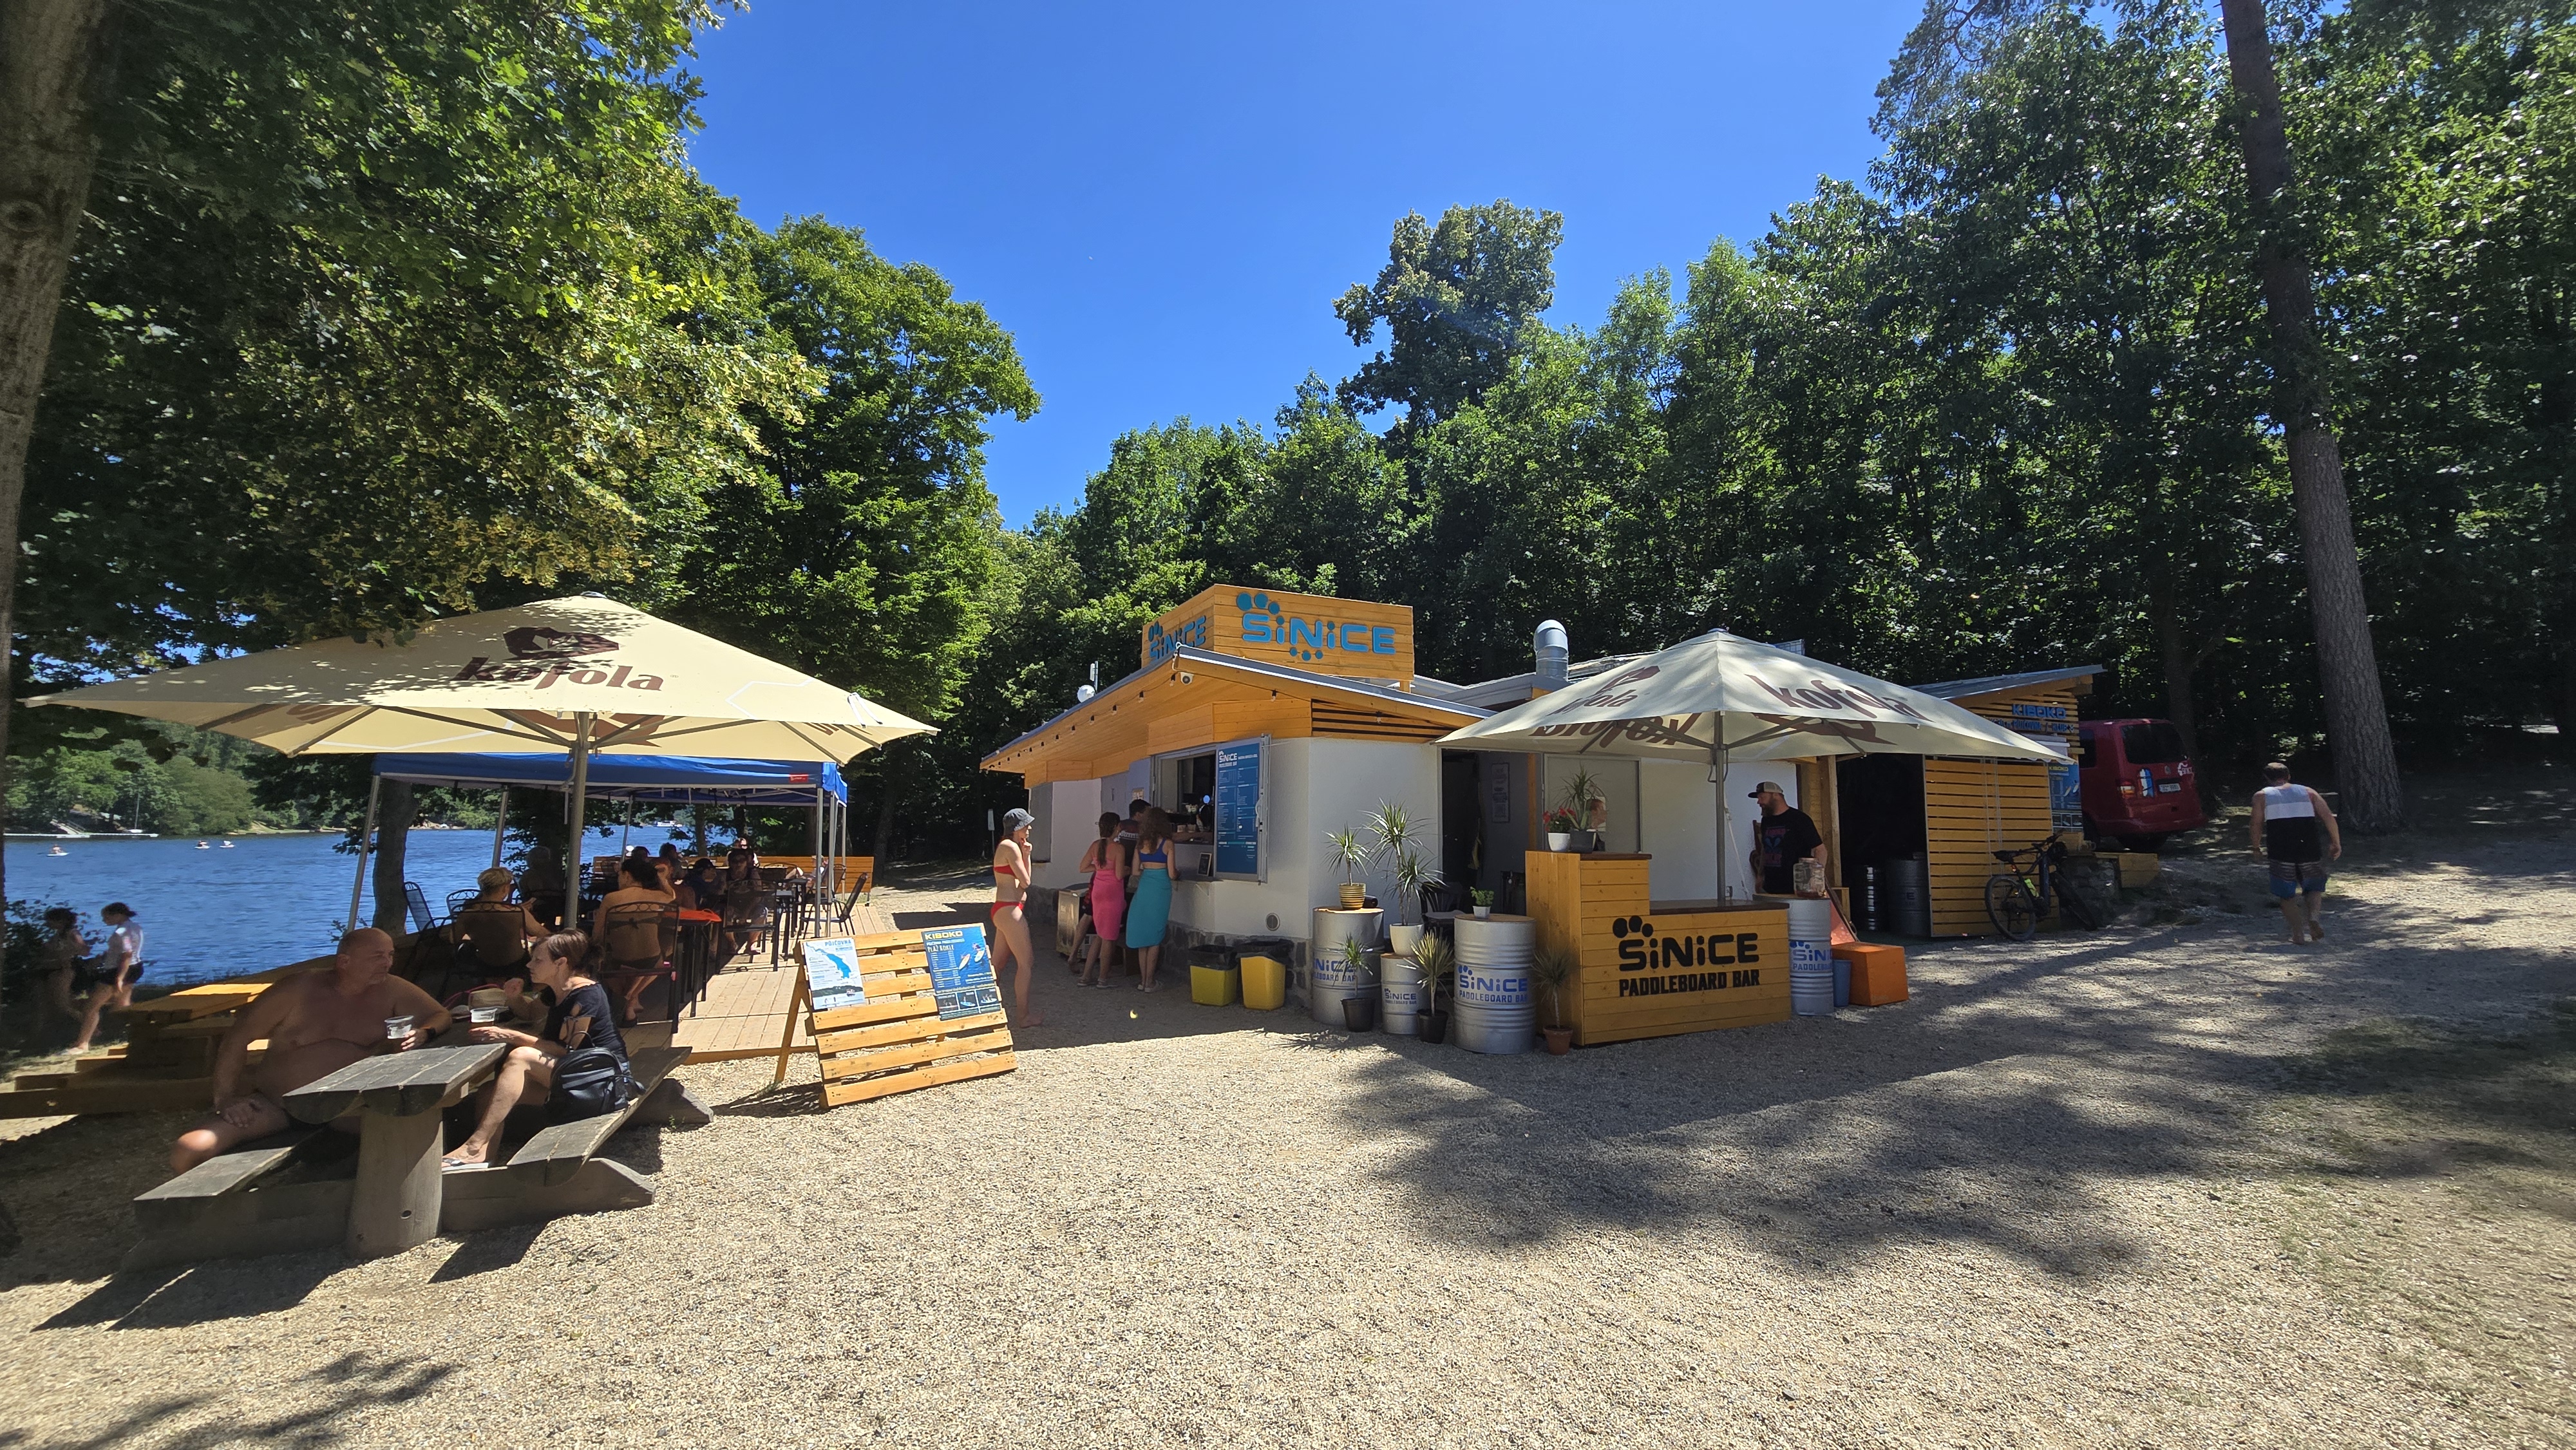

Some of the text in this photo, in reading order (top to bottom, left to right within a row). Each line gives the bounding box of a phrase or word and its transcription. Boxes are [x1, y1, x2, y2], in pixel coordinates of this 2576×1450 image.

[450, 655, 663, 692] kofola
[1743, 673, 1933, 722] kofola
[2011, 703, 2067, 720] KIBOKO
[925, 930, 963, 940] KIBOKO
[1619, 968, 1761, 997] PADDLEBOARD BAR
[1459, 990, 1513, 1003] PADDLEBOARD
